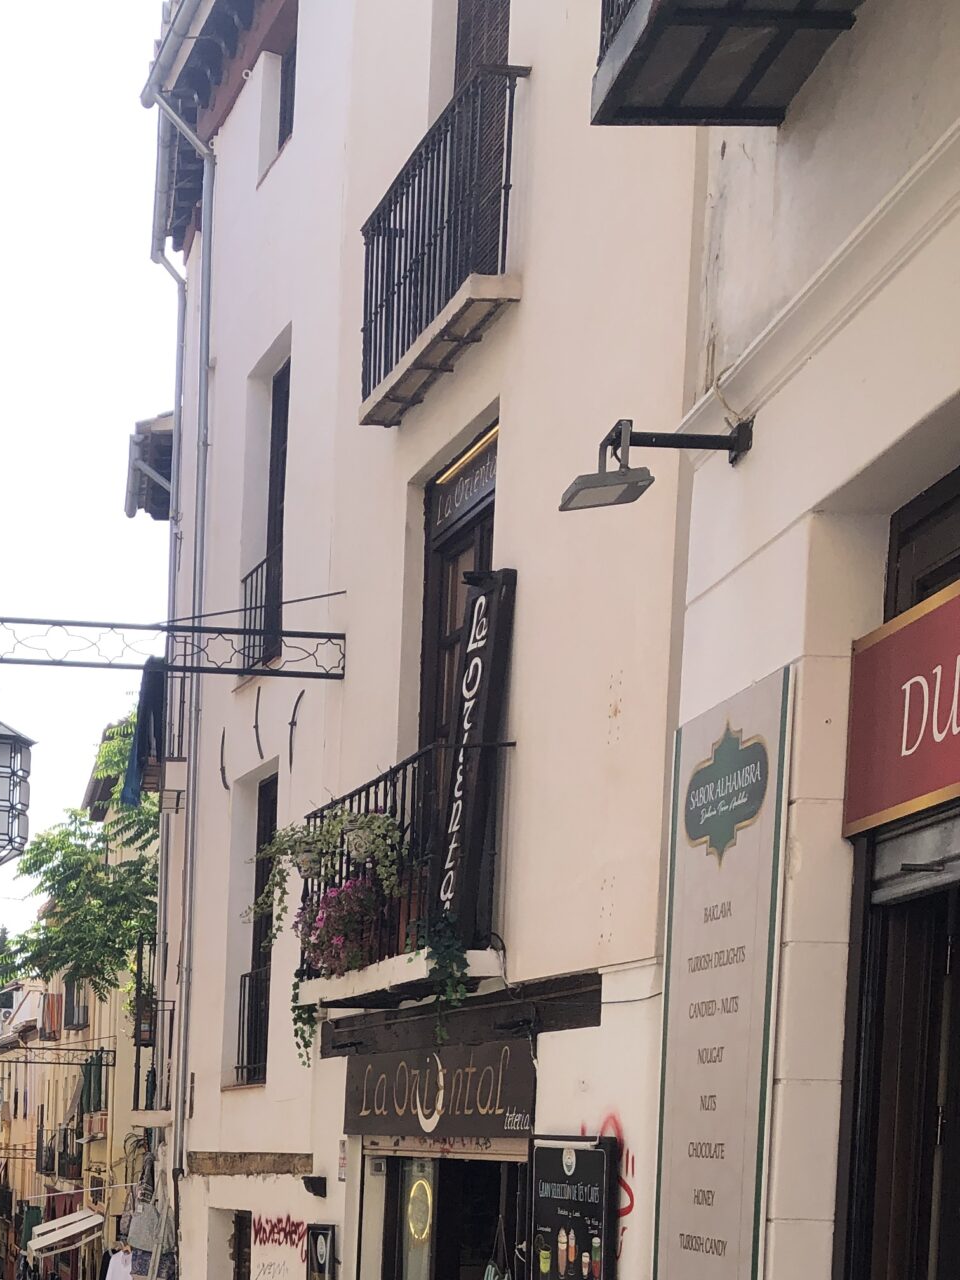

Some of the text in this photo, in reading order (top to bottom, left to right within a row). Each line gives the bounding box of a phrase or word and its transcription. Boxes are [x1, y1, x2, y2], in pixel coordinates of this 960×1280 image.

[467, 595, 488, 653] La
[690, 782, 715, 811] SABOR
[715, 761, 761, 799] ALHAMBRA
[703, 901, 732, 923] BAKLAVA
[688, 946, 746, 974] TURKISH DELIGHTS
[689, 999, 717, 1019] CANDIED
[721, 996, 739, 1015] NUTS
[697, 1046, 725, 1065] NOUGAT
[359, 1064, 388, 1117] La
[700, 1094, 717, 1111] NUTS
[688, 1142, 725, 1159] CHOCOLATE
[693, 1188, 715, 1206] HONEY
[679, 1233, 727, 1256] TURKISH CANDY
